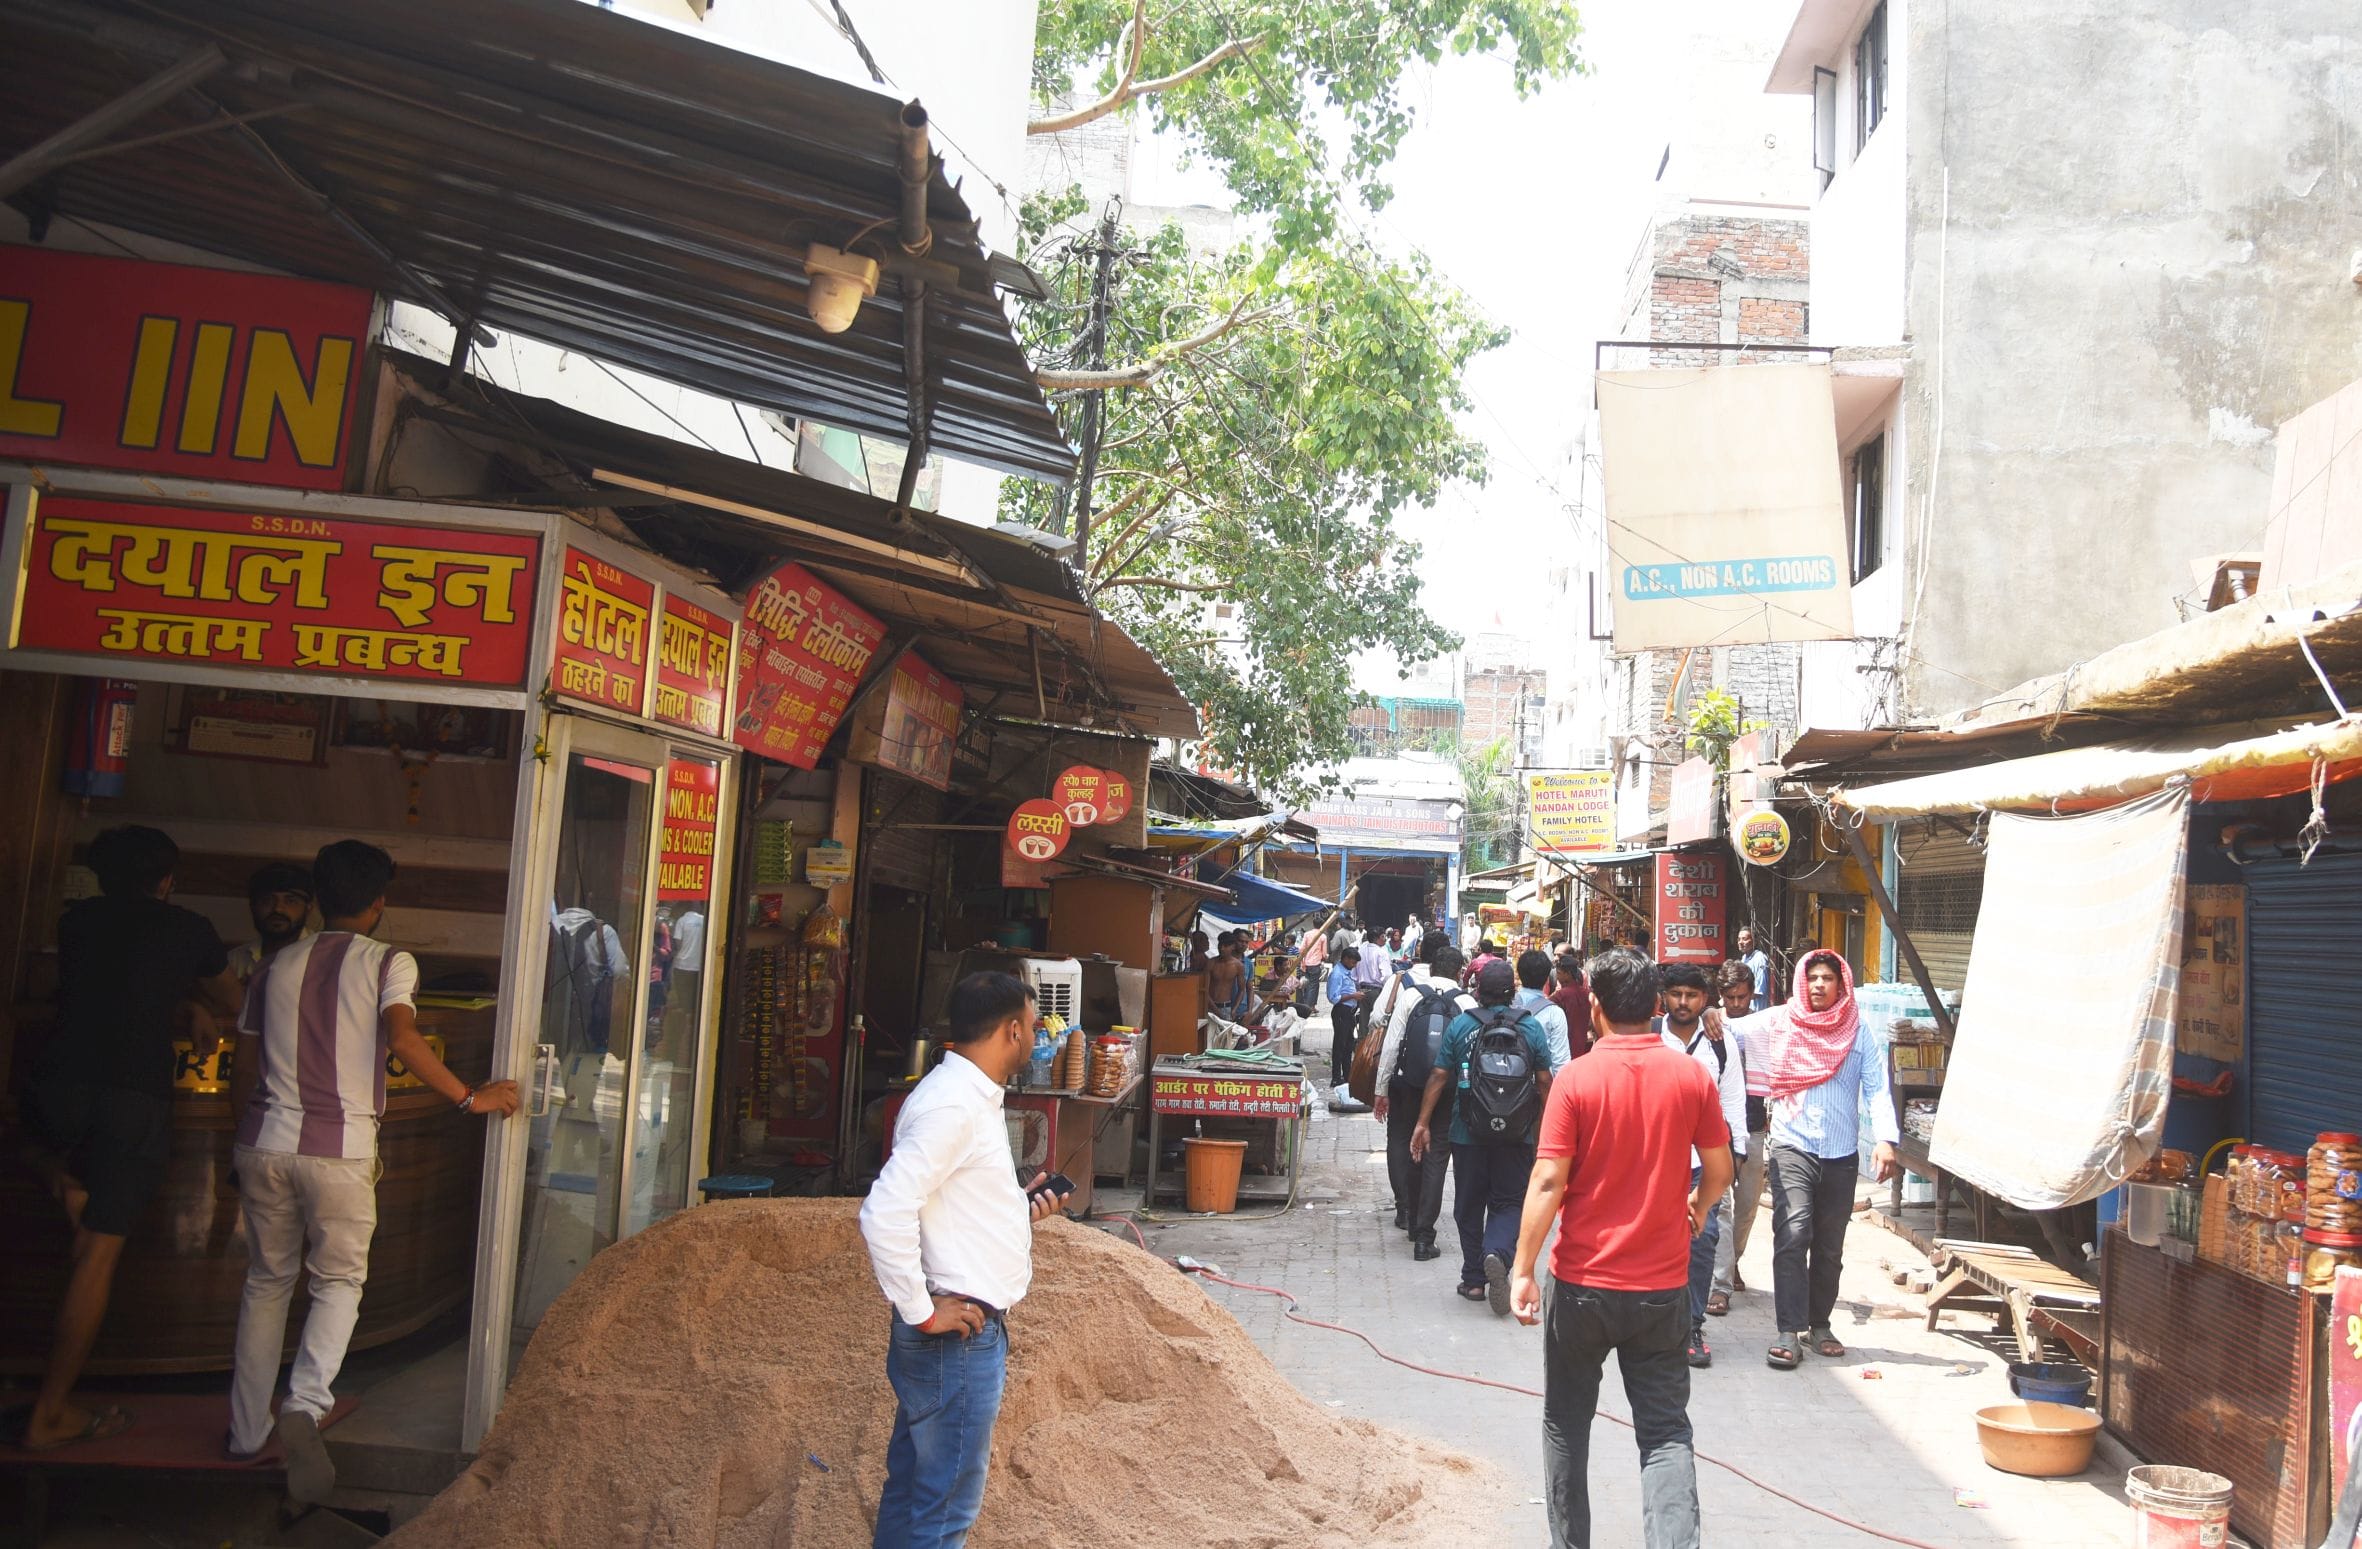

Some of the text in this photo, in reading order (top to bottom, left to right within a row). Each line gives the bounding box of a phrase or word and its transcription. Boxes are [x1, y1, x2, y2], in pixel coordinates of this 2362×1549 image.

[118, 315, 355, 467] IIN
[251, 516, 331, 536] S.S.D.N.
[44, 517, 526, 628] दयाल इन
[597, 562, 623, 585] S.S.D.N.
[1681, 565, 1717, 590] NON
[1723, 562, 1760, 588] A.C.
[1766, 559, 1832, 584] ROOMS
[562, 561, 647, 666] होटल
[687, 606, 709, 625] S.S.D.N.
[97, 608, 471, 677] उत्तम प्रबन्ध
[801, 608, 872, 678] टेलीकॉम
[707, 630, 731, 692] इन
[766, 646, 797, 678] मोबाइल
[561, 655, 636, 707] ठहरने का
[655, 683, 688, 722] उत्तम
[690, 693, 722, 736] प्रबन्ध
[674, 770, 696, 785] S.S.D.N.
[1082, 776, 1099, 788] चाय
[1544, 776, 1597, 786] Welcome to
[1067, 788, 1094, 802] कुल्हड़
[1536, 788, 1607, 800] HOTEL MARUTI
[697, 792, 715, 823] A.C.
[1371, 805, 1393, 817] JAIN
[1406, 808, 1431, 820] SONS
[1534, 801, 1609, 813] NANDAN LODGE
[1017, 812, 1064, 835] लस्सी
[1383, 817, 1447, 833] DISTRIBUTORS
[1542, 815, 1603, 825] FAMILY HOTEL
[674, 828, 681, 853] &
[682, 829, 714, 856] COOLER
[1668, 860, 1715, 880] देशी
[1664, 883, 1719, 898] शराब
[1678, 901, 1706, 920] की
[1664, 923, 1720, 943] दुकान
[1156, 1079, 1298, 1098] आर्डर पर पैकिंग होती है
[1272, 1101, 1290, 1113] मिलती
